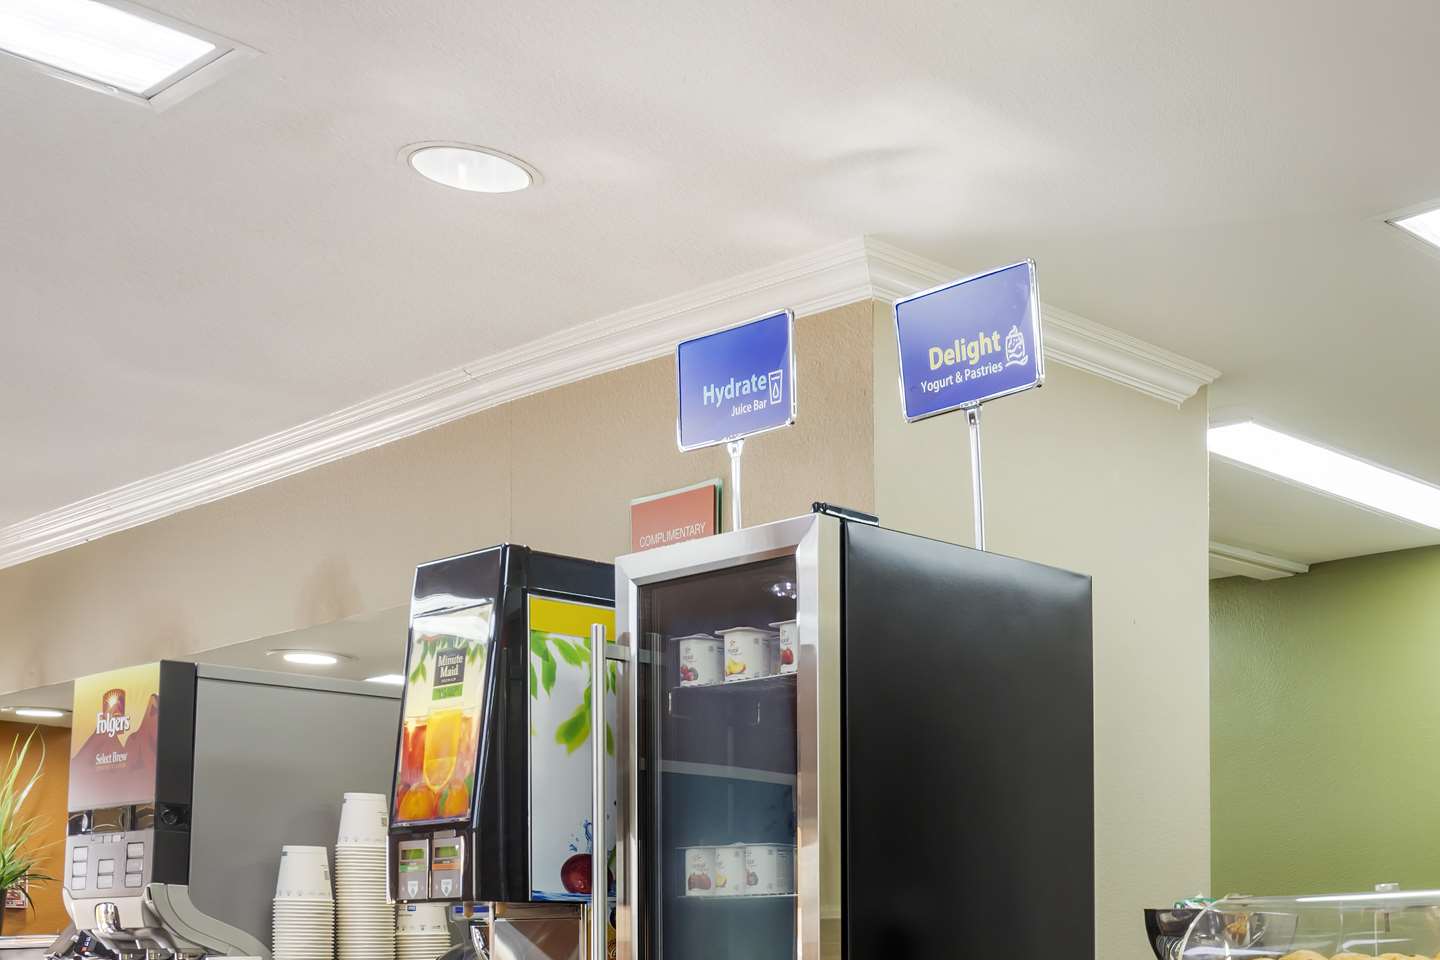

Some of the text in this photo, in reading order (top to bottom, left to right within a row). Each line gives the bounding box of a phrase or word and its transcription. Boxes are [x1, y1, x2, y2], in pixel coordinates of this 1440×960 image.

[928, 330, 1001, 370] Delight
[920, 361, 1004, 393] Yogurt & Pastries
[703, 373, 767, 408] Hydrate
[731, 399, 768, 417] Juice Bar
[639, 521, 706, 548] COMPLIMENTARY
[438, 655, 464, 667] Minute
[440, 664, 459, 678] Maid
[96, 712, 130, 738] Folgers
[95, 752, 128, 765] Select Brew
